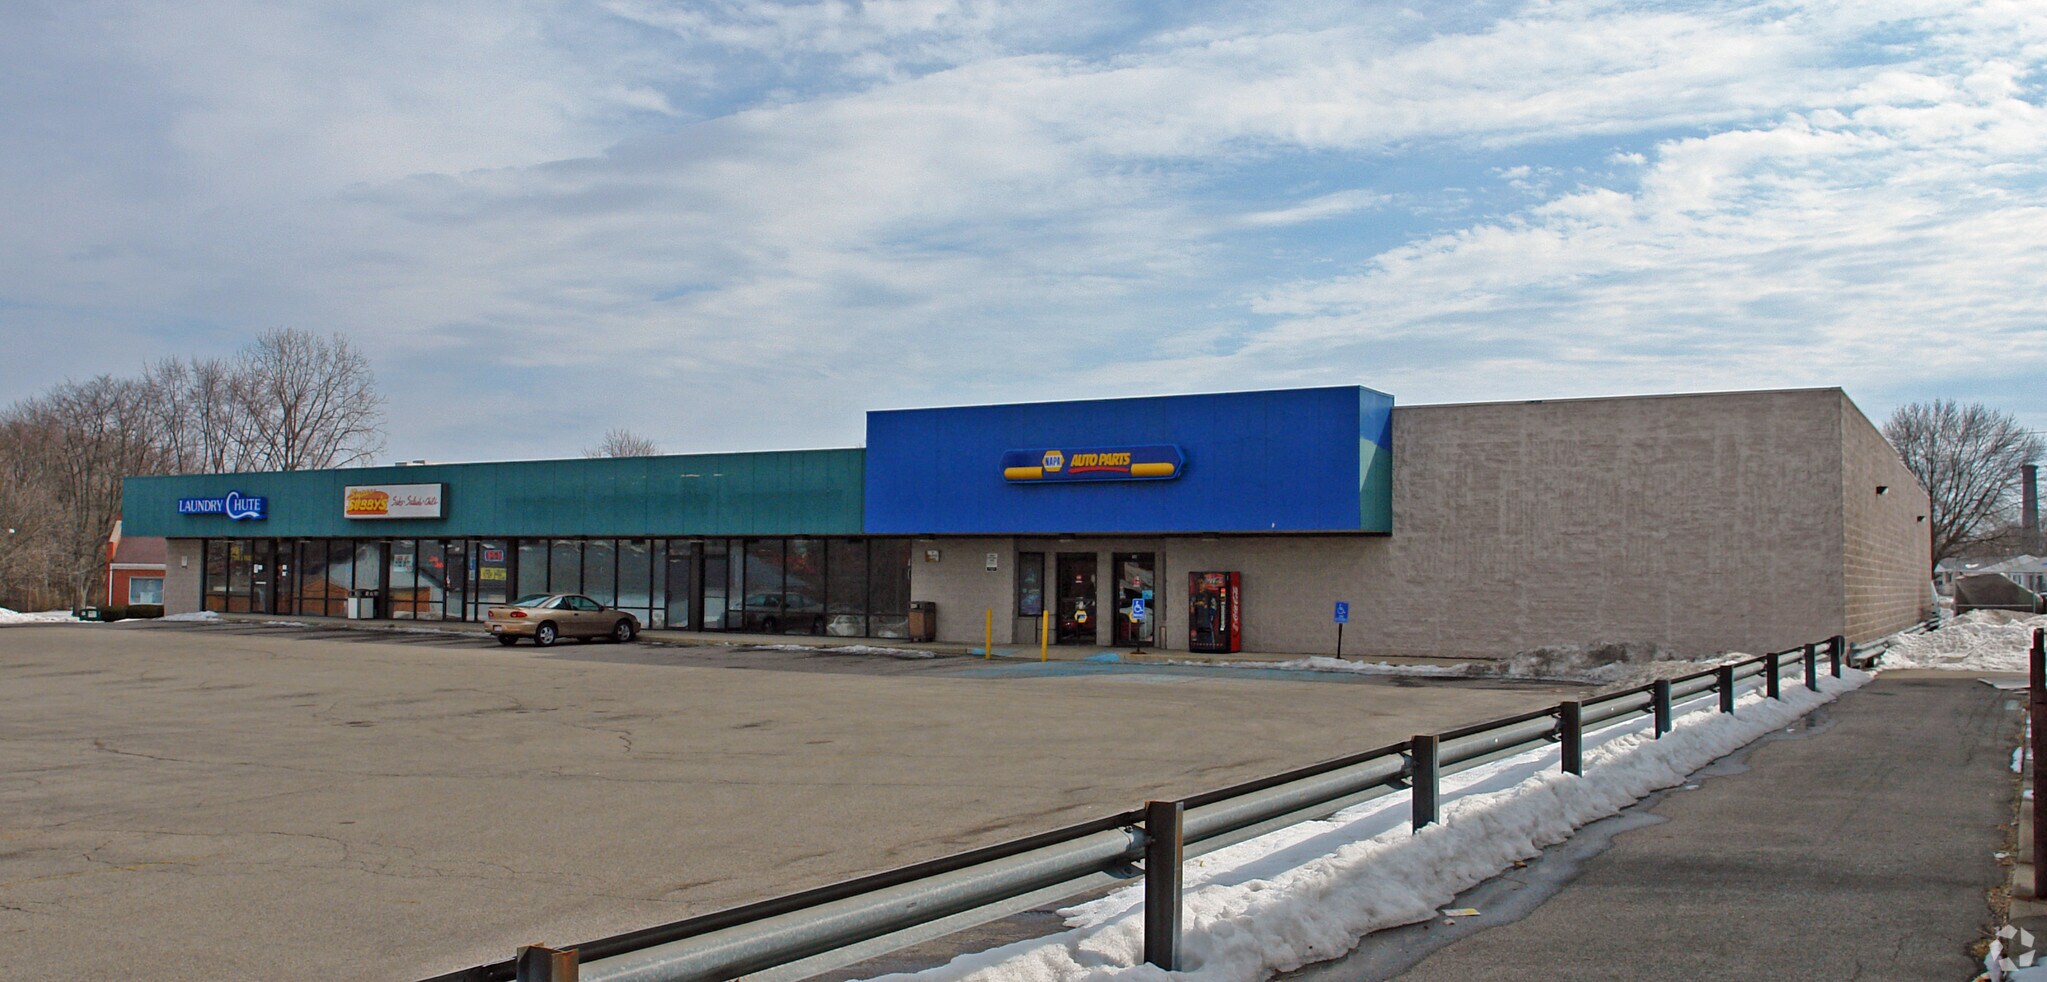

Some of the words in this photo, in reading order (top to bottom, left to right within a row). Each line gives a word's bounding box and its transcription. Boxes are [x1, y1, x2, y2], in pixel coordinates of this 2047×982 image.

[1045, 456, 1061, 467] NAPA
[1070, 453, 1098, 467] AUTO
[1099, 452, 1131, 466] PARTS
[179, 500, 223, 512] LAUNDRY
[226, 491, 261, 519] CHUTE
[347, 495, 388, 511] SUBBY'S
